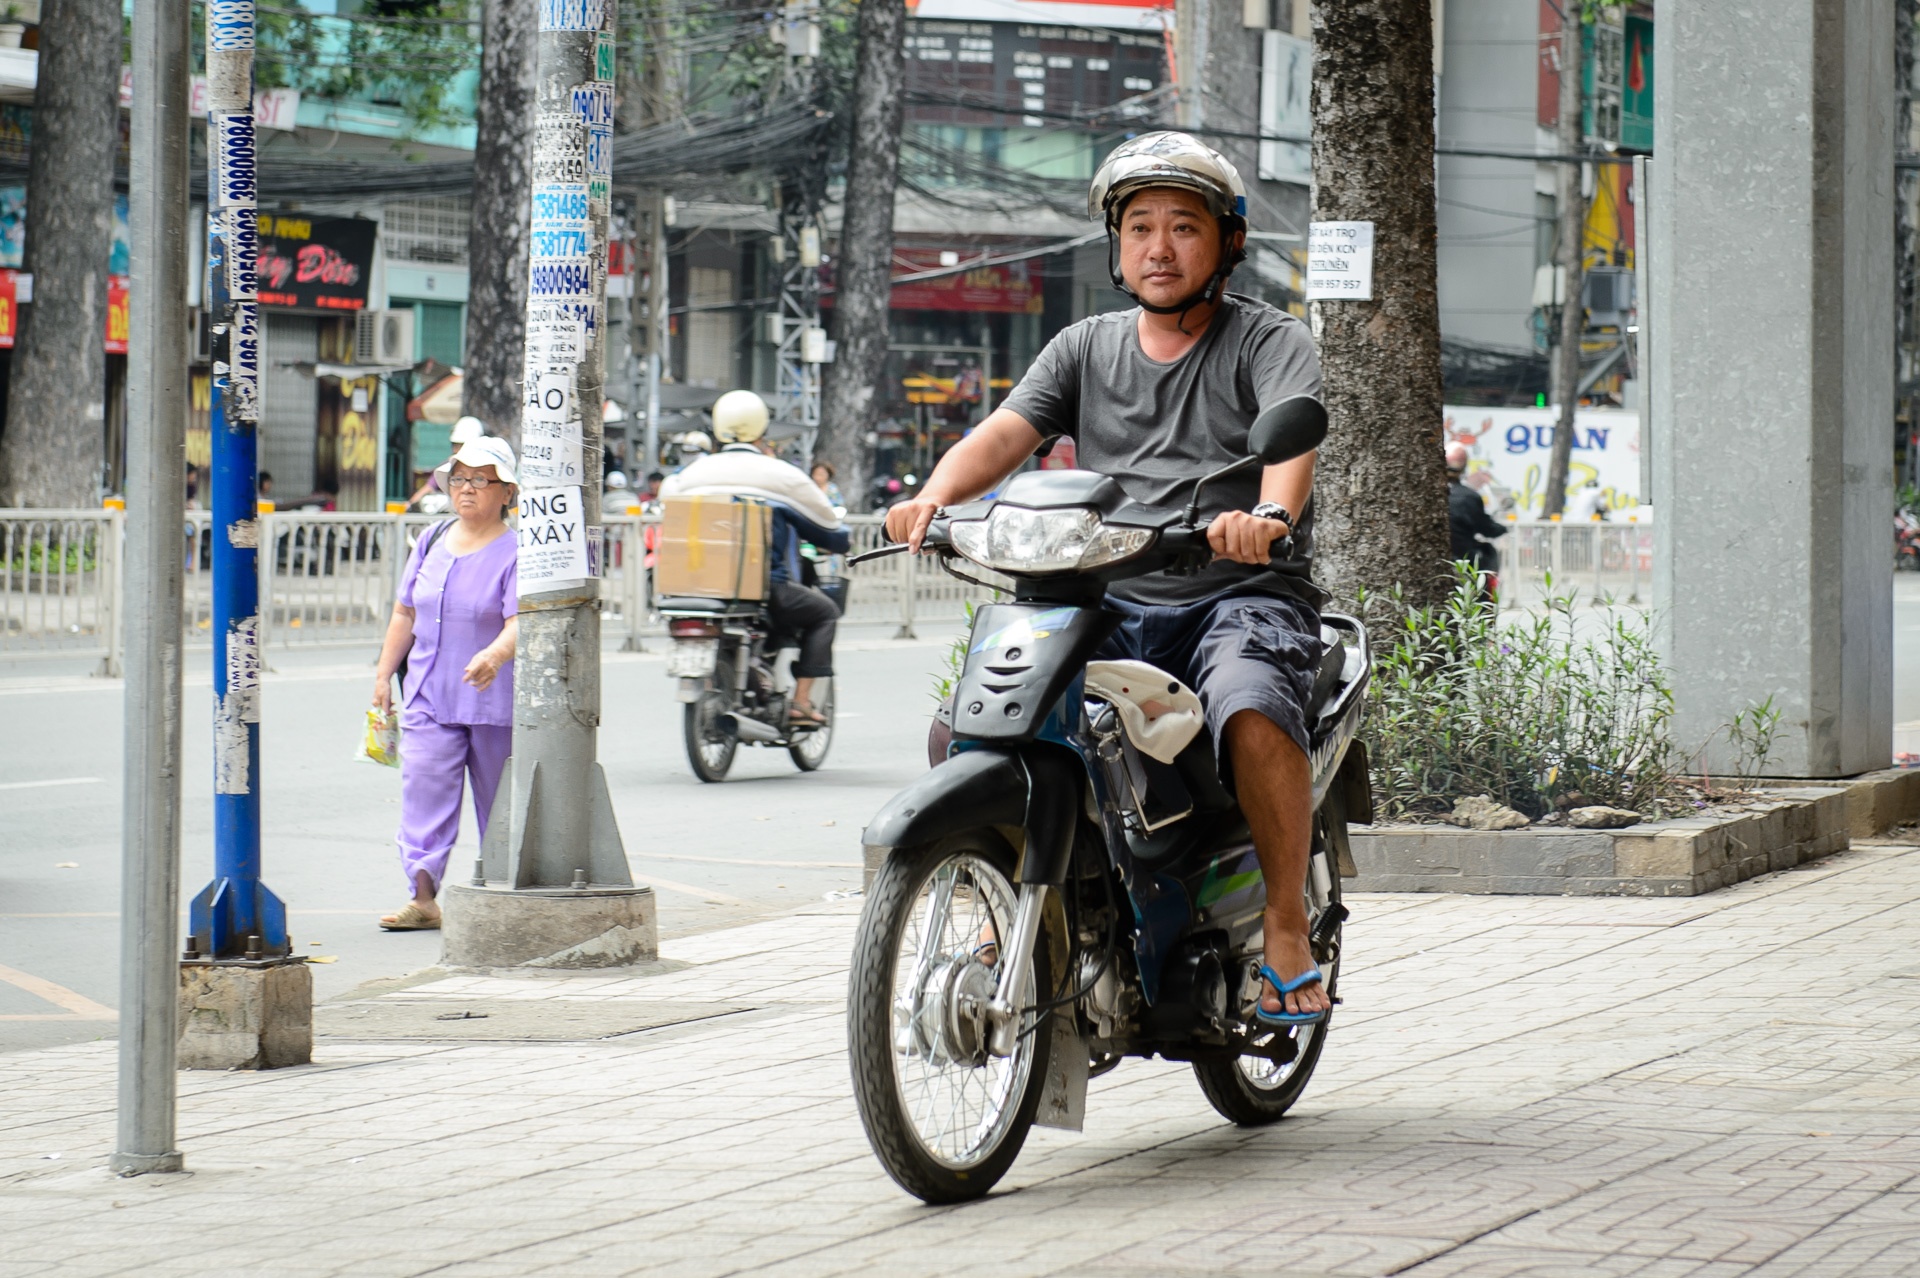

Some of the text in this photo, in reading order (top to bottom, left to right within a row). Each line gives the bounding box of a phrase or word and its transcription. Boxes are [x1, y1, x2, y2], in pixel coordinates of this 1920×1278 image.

[227, 115, 255, 201] 39800984
[1343, 280, 1361, 289] 957
[530, 519, 575, 547] XÂY
